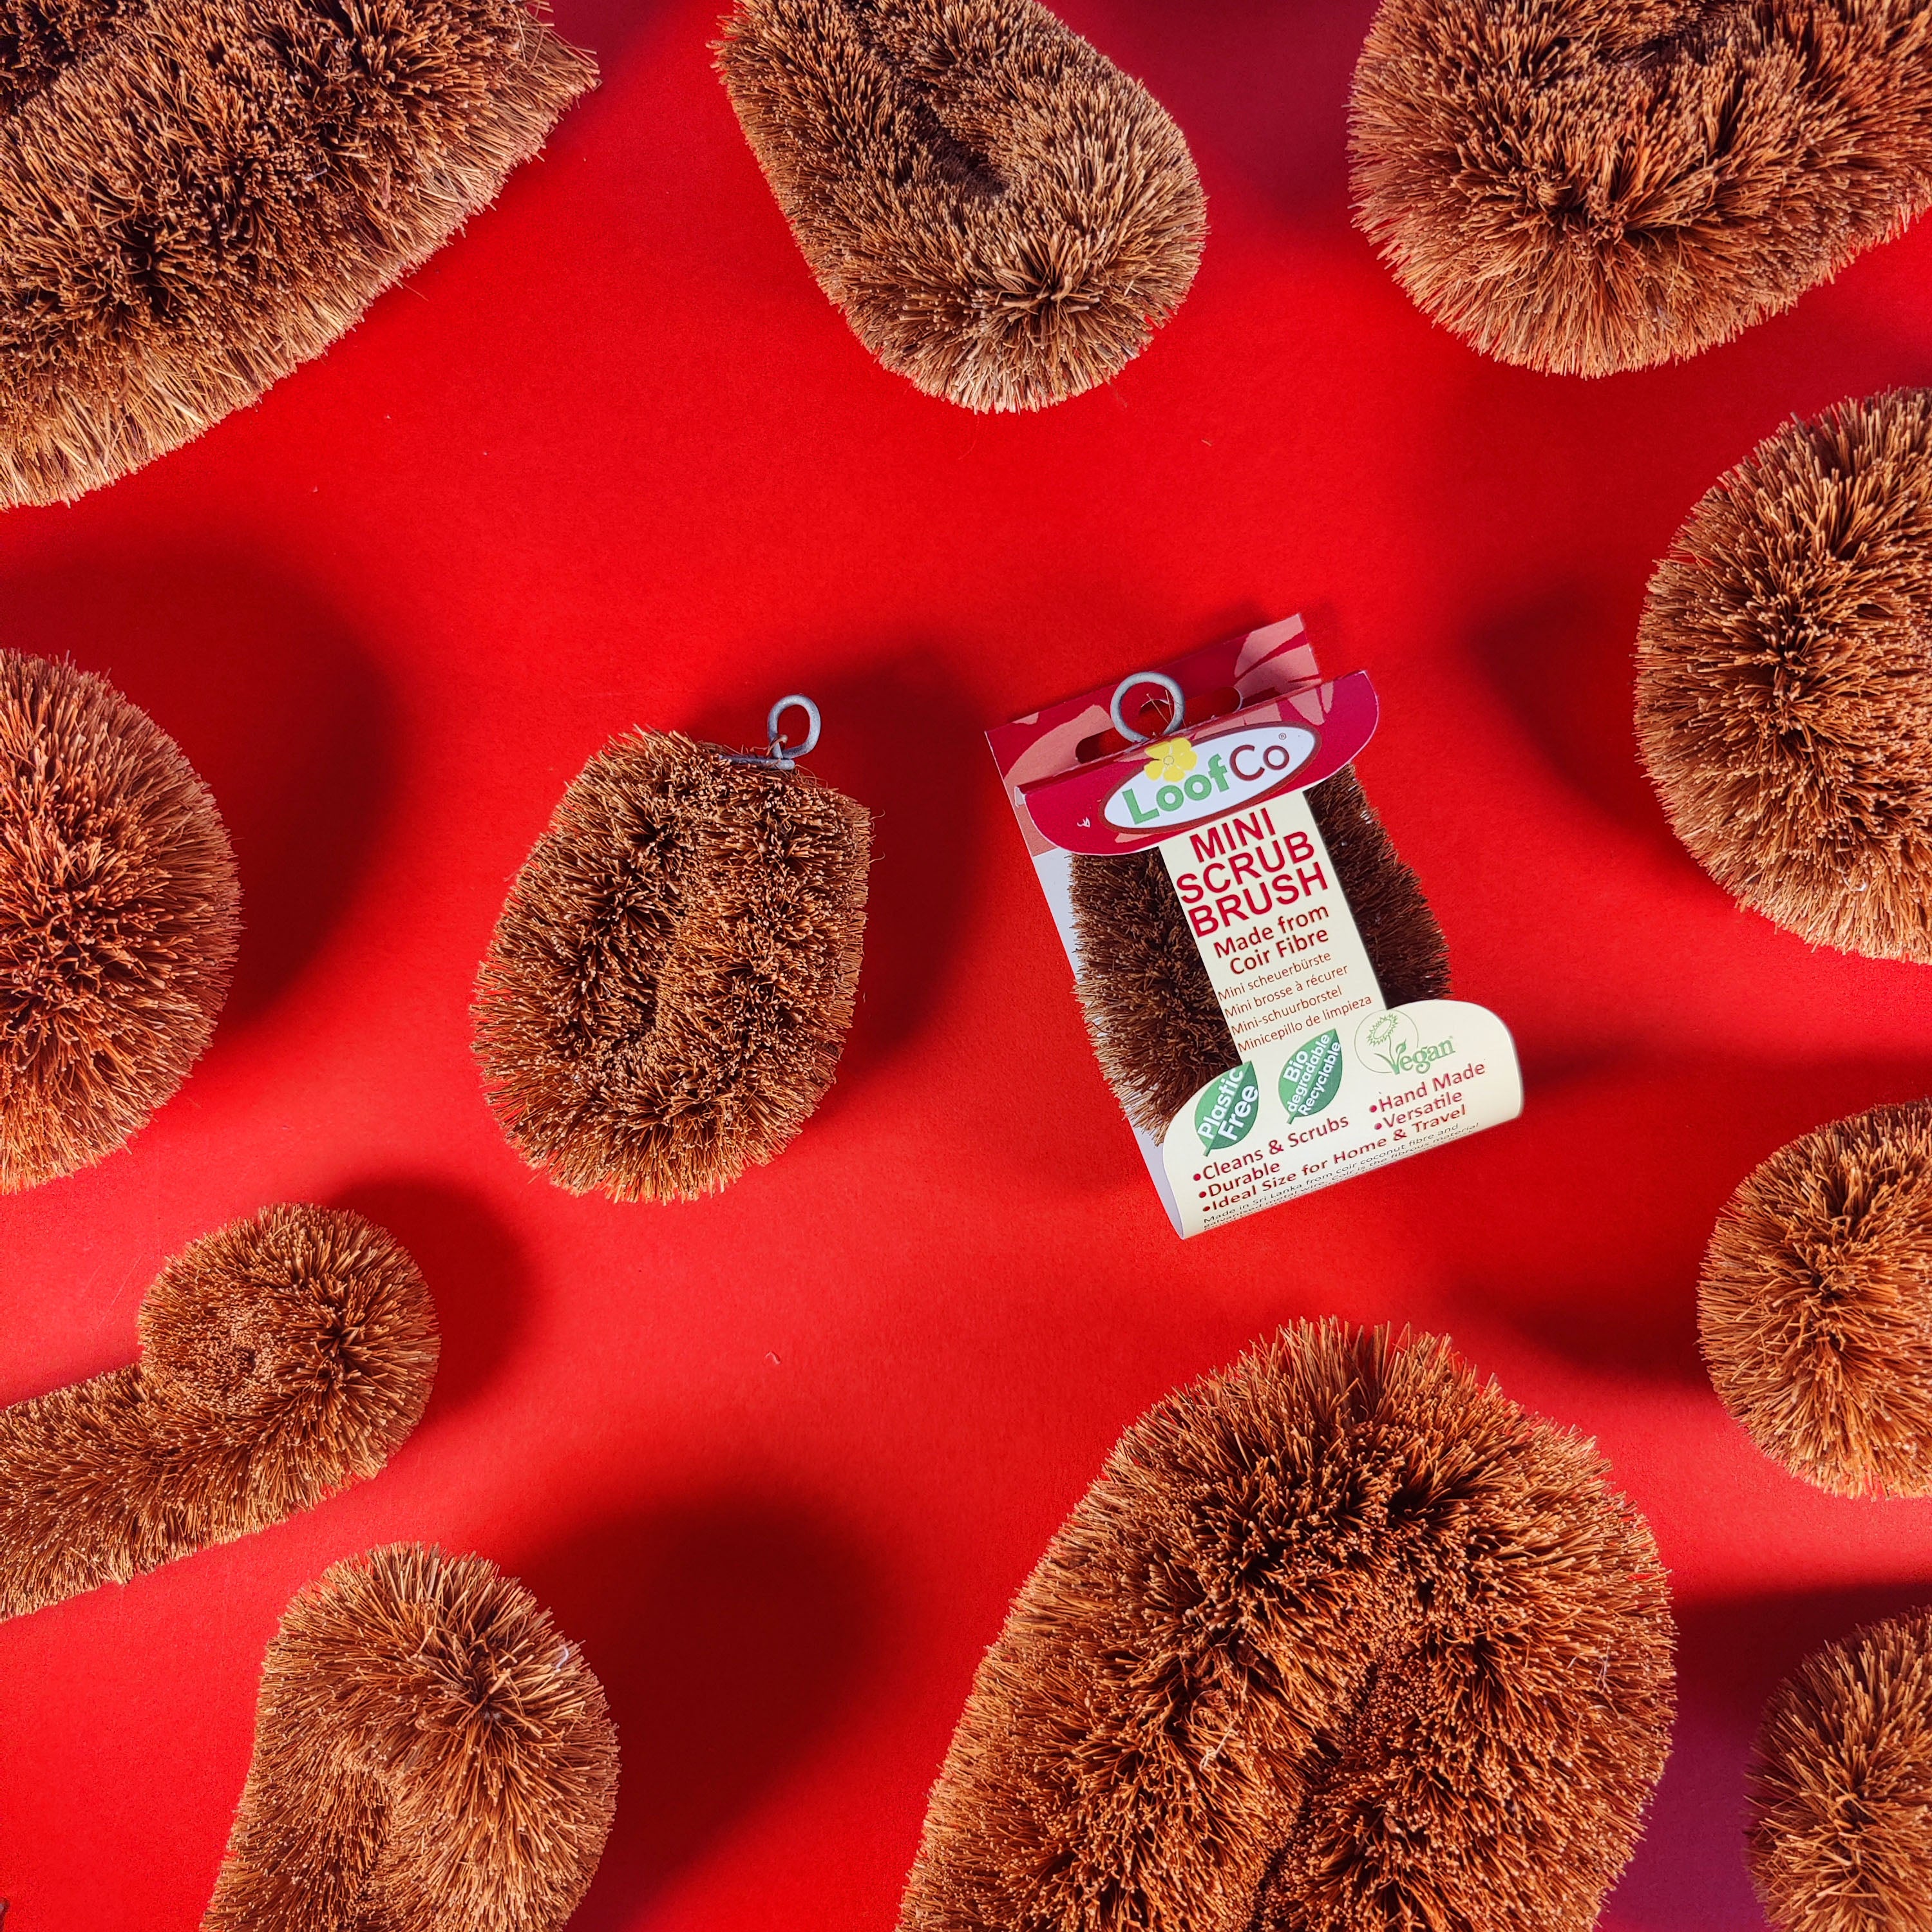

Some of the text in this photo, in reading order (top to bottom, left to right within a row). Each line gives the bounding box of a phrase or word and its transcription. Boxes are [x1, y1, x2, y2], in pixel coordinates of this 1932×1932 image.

[1122, 744, 1289, 825] LoofCo
[1189, 808, 1275, 863] MINI
[1177, 831, 1314, 904] SCRUB
[1188, 862, 1328, 938] BRUSH
[1213, 906, 1329, 958] Made from
[1230, 929, 1329, 974] Coir Fibre
[1218, 952, 1331, 1001] Mini scheuerbürste
[1224, 964, 1348, 1018] Mini brosse à récurer
[1231, 985, 1342, 1036] Mini-schuurborstel
[1238, 995, 1372, 1052] Minicepillo de limpieza
[1283, 1050, 1309, 1083] Bio
[1287, 1034, 1331, 1113] degradable
[1298, 1042, 1341, 1115] Recyclable
[1374, 1038, 1455, 1074] Vegan
[1197, 1068, 1244, 1140] Plastic
[1218, 1085, 1258, 1141] Free
[1378, 1063, 1485, 1112] Hand Made
[1383, 1092, 1463, 1128] Versatile
[1202, 1116, 1349, 1180] Cleans & Scrubs
[1204, 1209, 1235, 1223] Made
[1253, 1196, 1267, 1204] Sri
[1271, 1184, 1302, 1198] Lanka
[1306, 1172, 1332, 1185] from
[1336, 1162, 1358, 1173] coir
[1360, 1144, 1405, 1164] coconut
[1409, 1134, 1434, 1146] fibre
[1437, 1123, 1458, 1136] and
[1212, 1104, 1466, 1210] Ideal Size for Home & Travel
[1208, 1162, 1280, 1197] Durable
